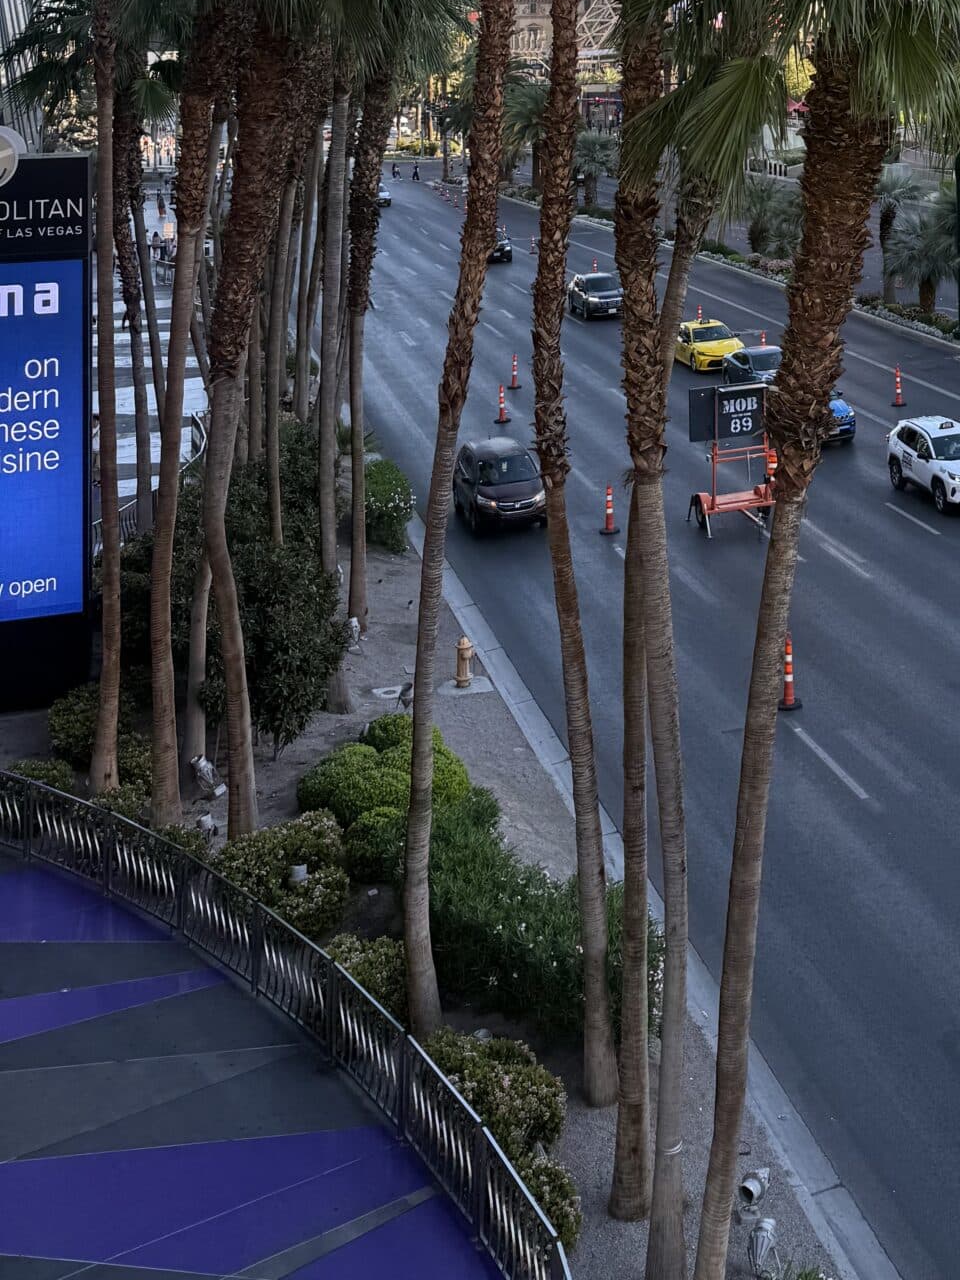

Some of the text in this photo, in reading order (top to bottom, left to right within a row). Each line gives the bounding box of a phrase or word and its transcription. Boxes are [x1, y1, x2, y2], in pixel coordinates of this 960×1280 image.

[6, 227, 33, 238] LAS
[38, 225, 83, 236] VEGAS
[24, 357, 59, 379] on
[722, 396, 758, 414] MOB
[731, 417, 753, 433] 89
[9, 577, 57, 598] open
